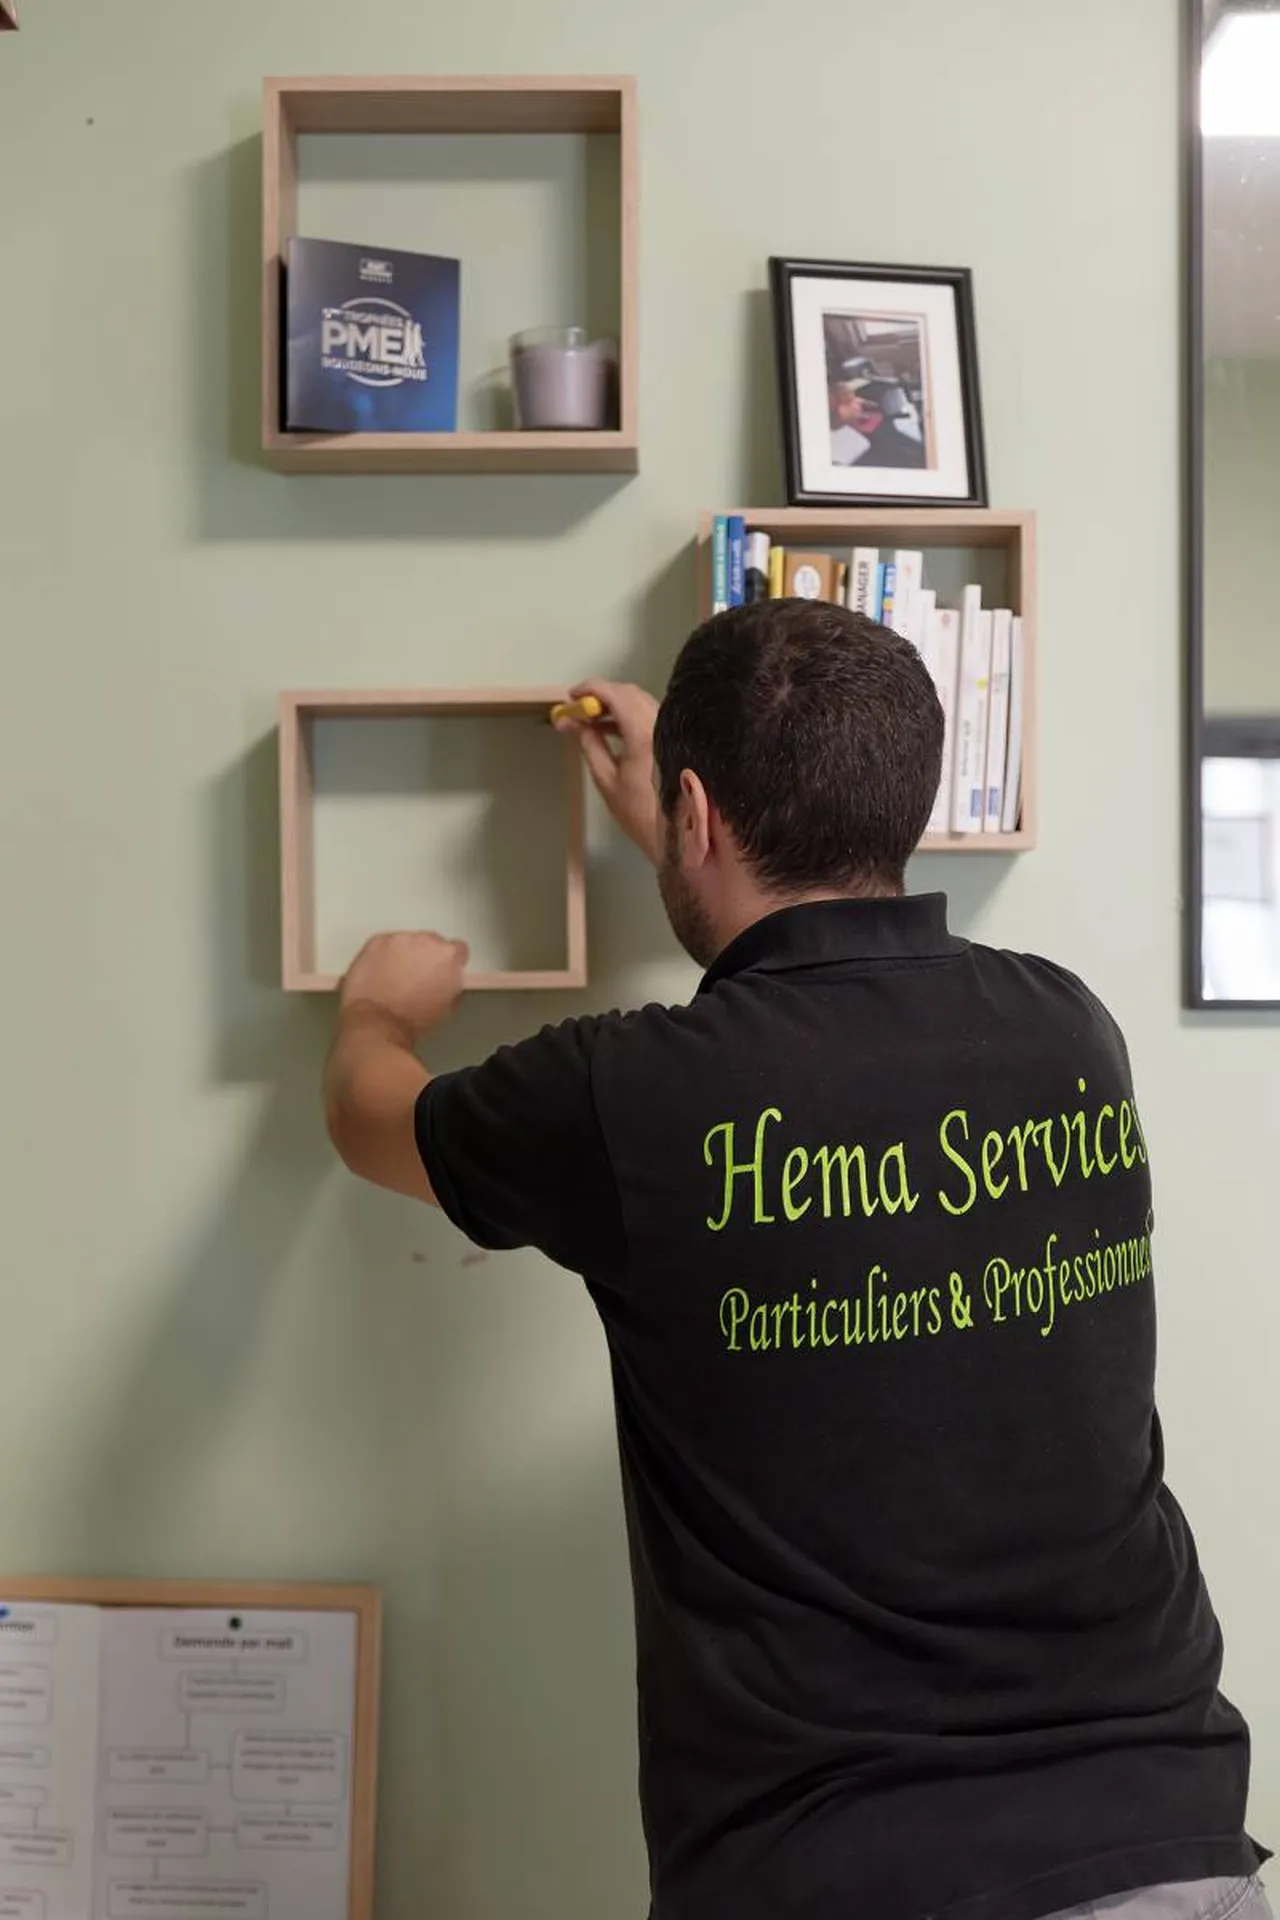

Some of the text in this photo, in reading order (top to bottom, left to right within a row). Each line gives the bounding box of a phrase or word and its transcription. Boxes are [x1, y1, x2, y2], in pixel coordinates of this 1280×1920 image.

[321, 319, 405, 365] PME
[856, 560, 870, 615] ANAGER
[703, 1107, 918, 1231] Hema
[719, 1264, 943, 1351] Particuliers
[949, 1271, 975, 1330] &
